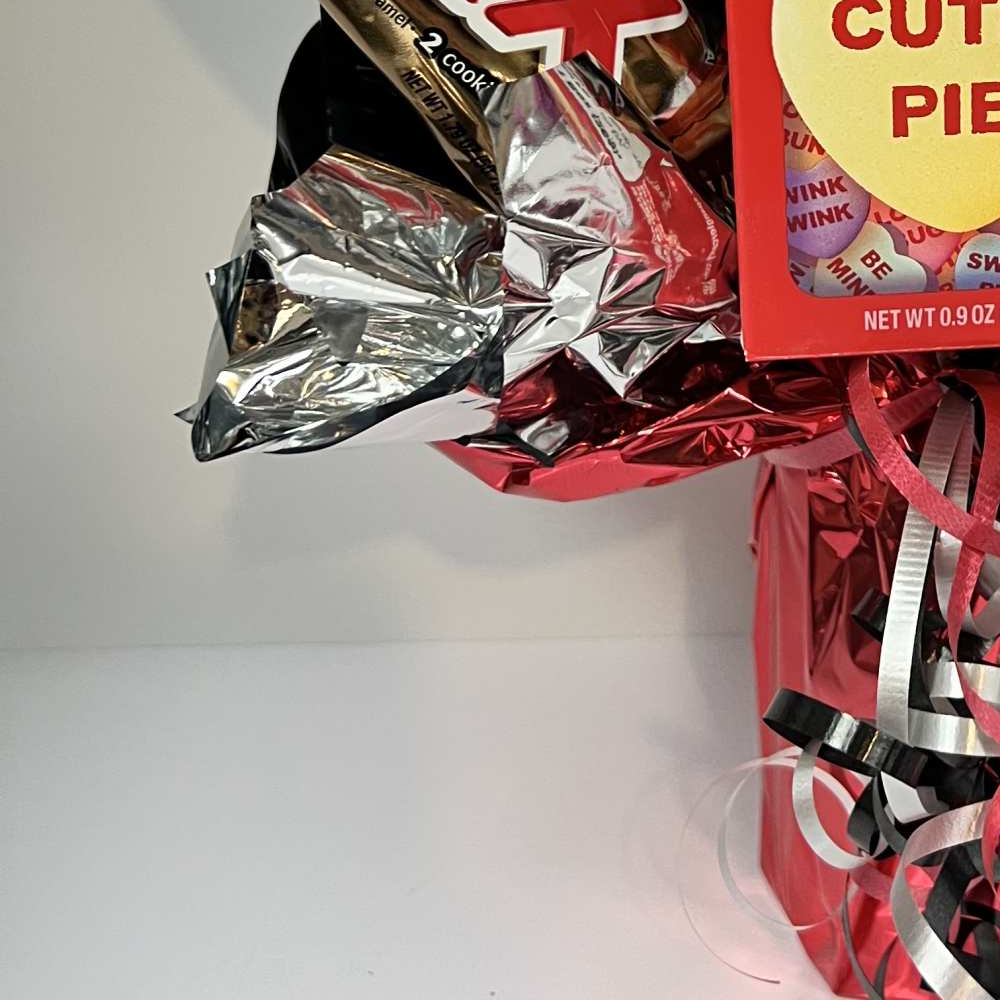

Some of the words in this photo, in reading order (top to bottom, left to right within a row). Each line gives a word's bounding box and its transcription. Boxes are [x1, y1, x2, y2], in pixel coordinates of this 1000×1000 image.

[419, 32, 443, 54] 2
[402, 69, 432, 94] NET
[421, 92, 450, 114] WT
[787, 202, 855, 234] WINK
[860, 248, 894, 281] BE
[864, 309, 900, 331] NET
[904, 307, 936, 329] WT
[939, 305, 968, 328] 0.9
[971, 303, 995, 325] OZ
